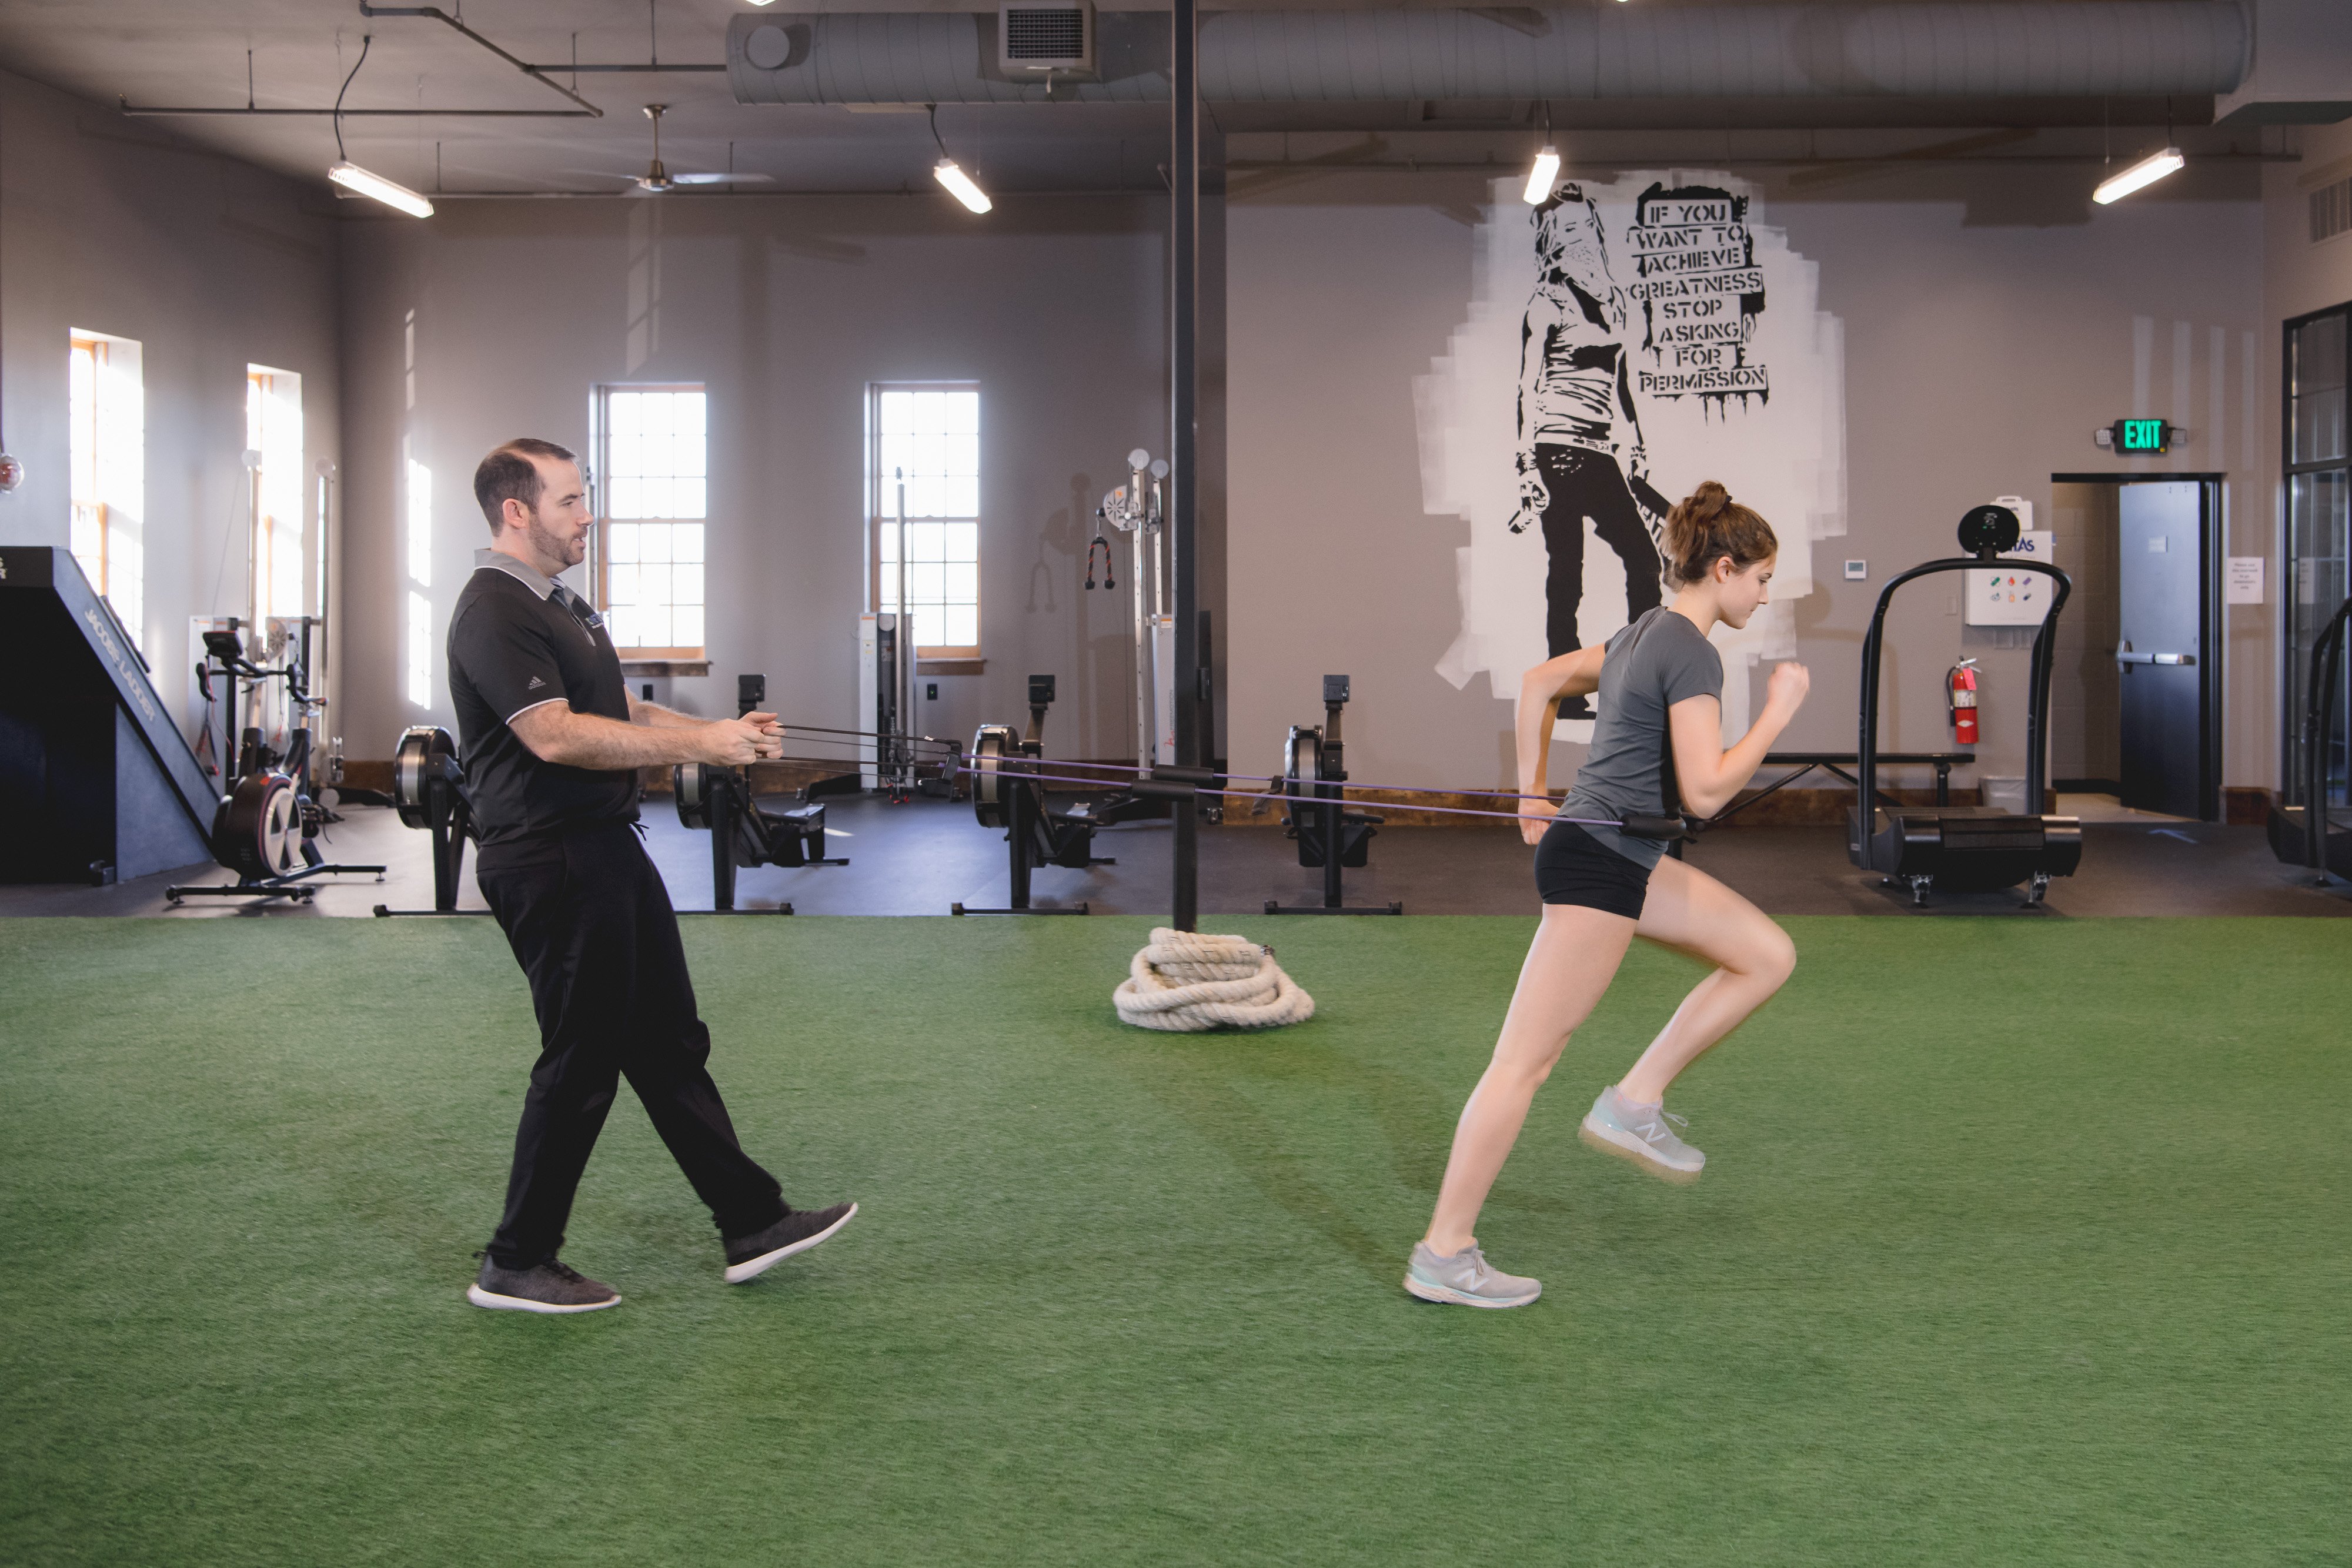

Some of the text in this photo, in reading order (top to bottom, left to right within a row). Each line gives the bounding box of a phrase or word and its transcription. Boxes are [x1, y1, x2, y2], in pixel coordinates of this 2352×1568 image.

[1651, 205, 1725, 223] IF YOU
[1636, 225, 1744, 250] WANT TO
[1648, 248, 1740, 274] ACHIEVE
[1630, 272, 1761, 300] GREATNESS
[1663, 299, 1722, 319] STOP
[1659, 322, 1739, 343] ASKING
[1676, 349, 1722, 367] FOR
[1640, 369, 1764, 392] PERMISSION
[2124, 420, 2161, 449] EXIT
[528, 682, 546, 690] adidas
